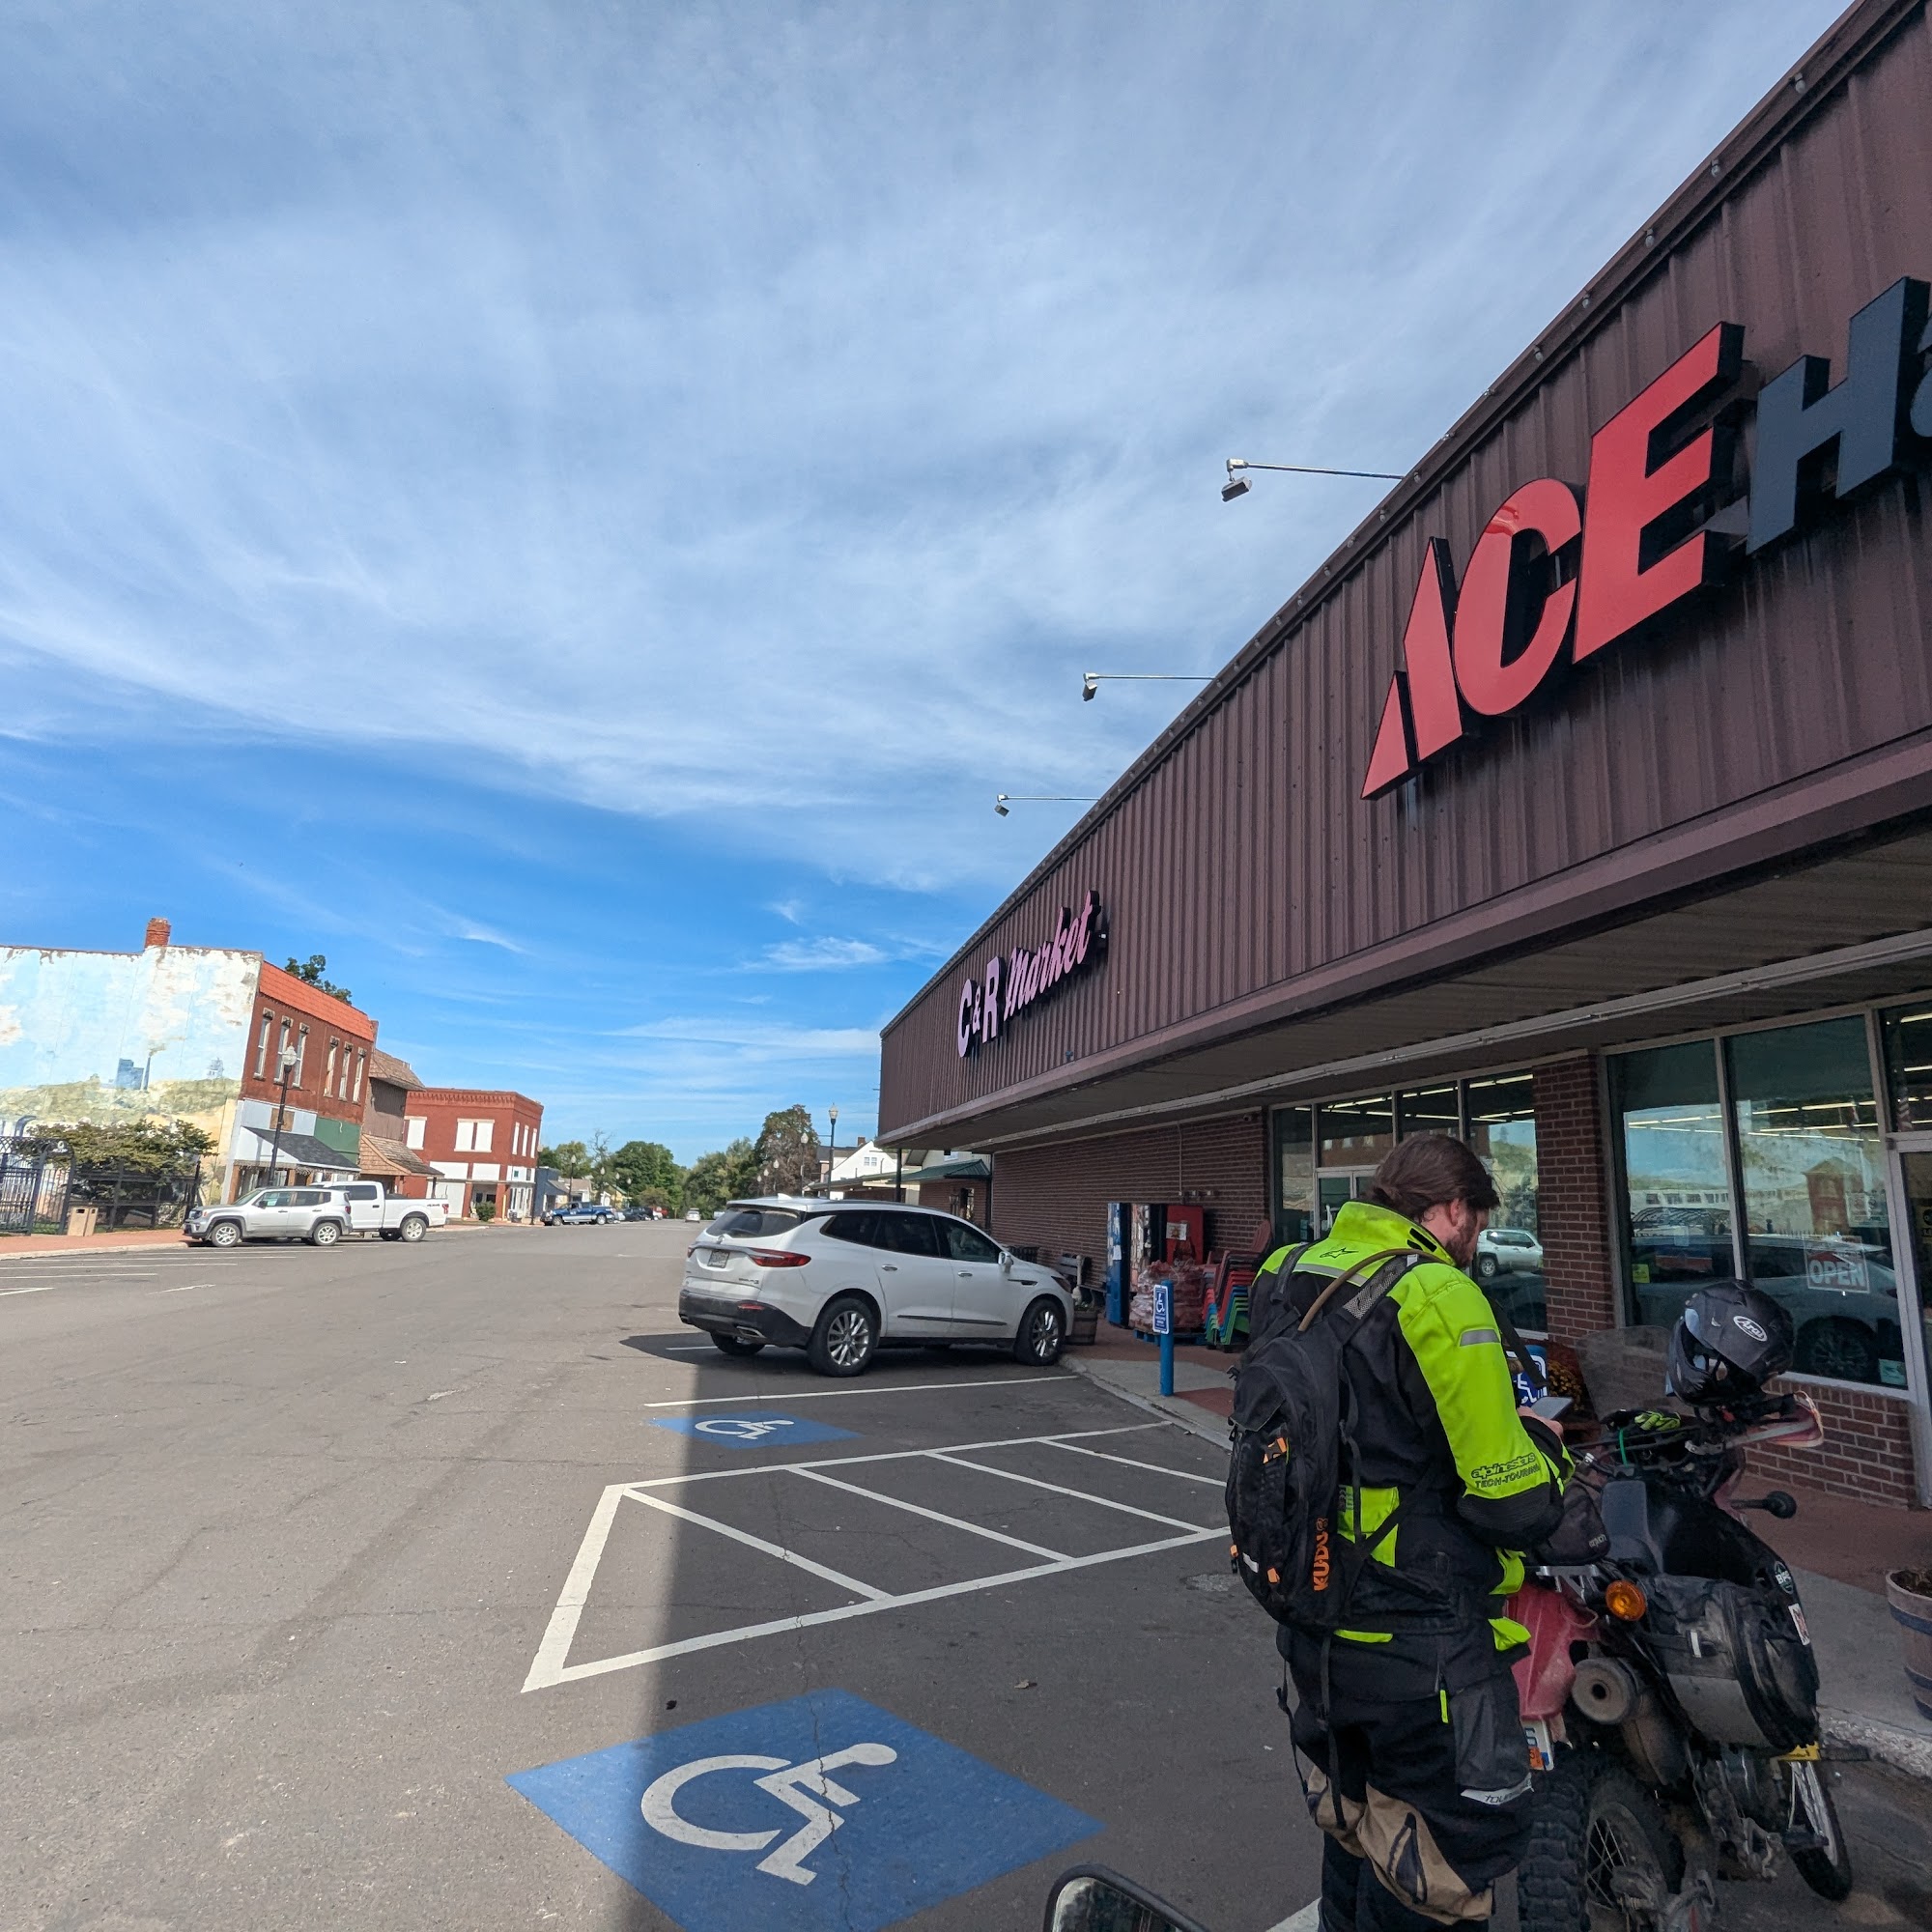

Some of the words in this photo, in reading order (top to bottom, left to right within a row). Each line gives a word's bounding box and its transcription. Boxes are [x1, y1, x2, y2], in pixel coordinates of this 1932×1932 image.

[1361, 324, 1723, 800] ACE
[1003, 891, 1093, 1022] Market
[1808, 1259, 1866, 1287] OPEN
[1471, 1452, 1537, 1480] alpinestars
